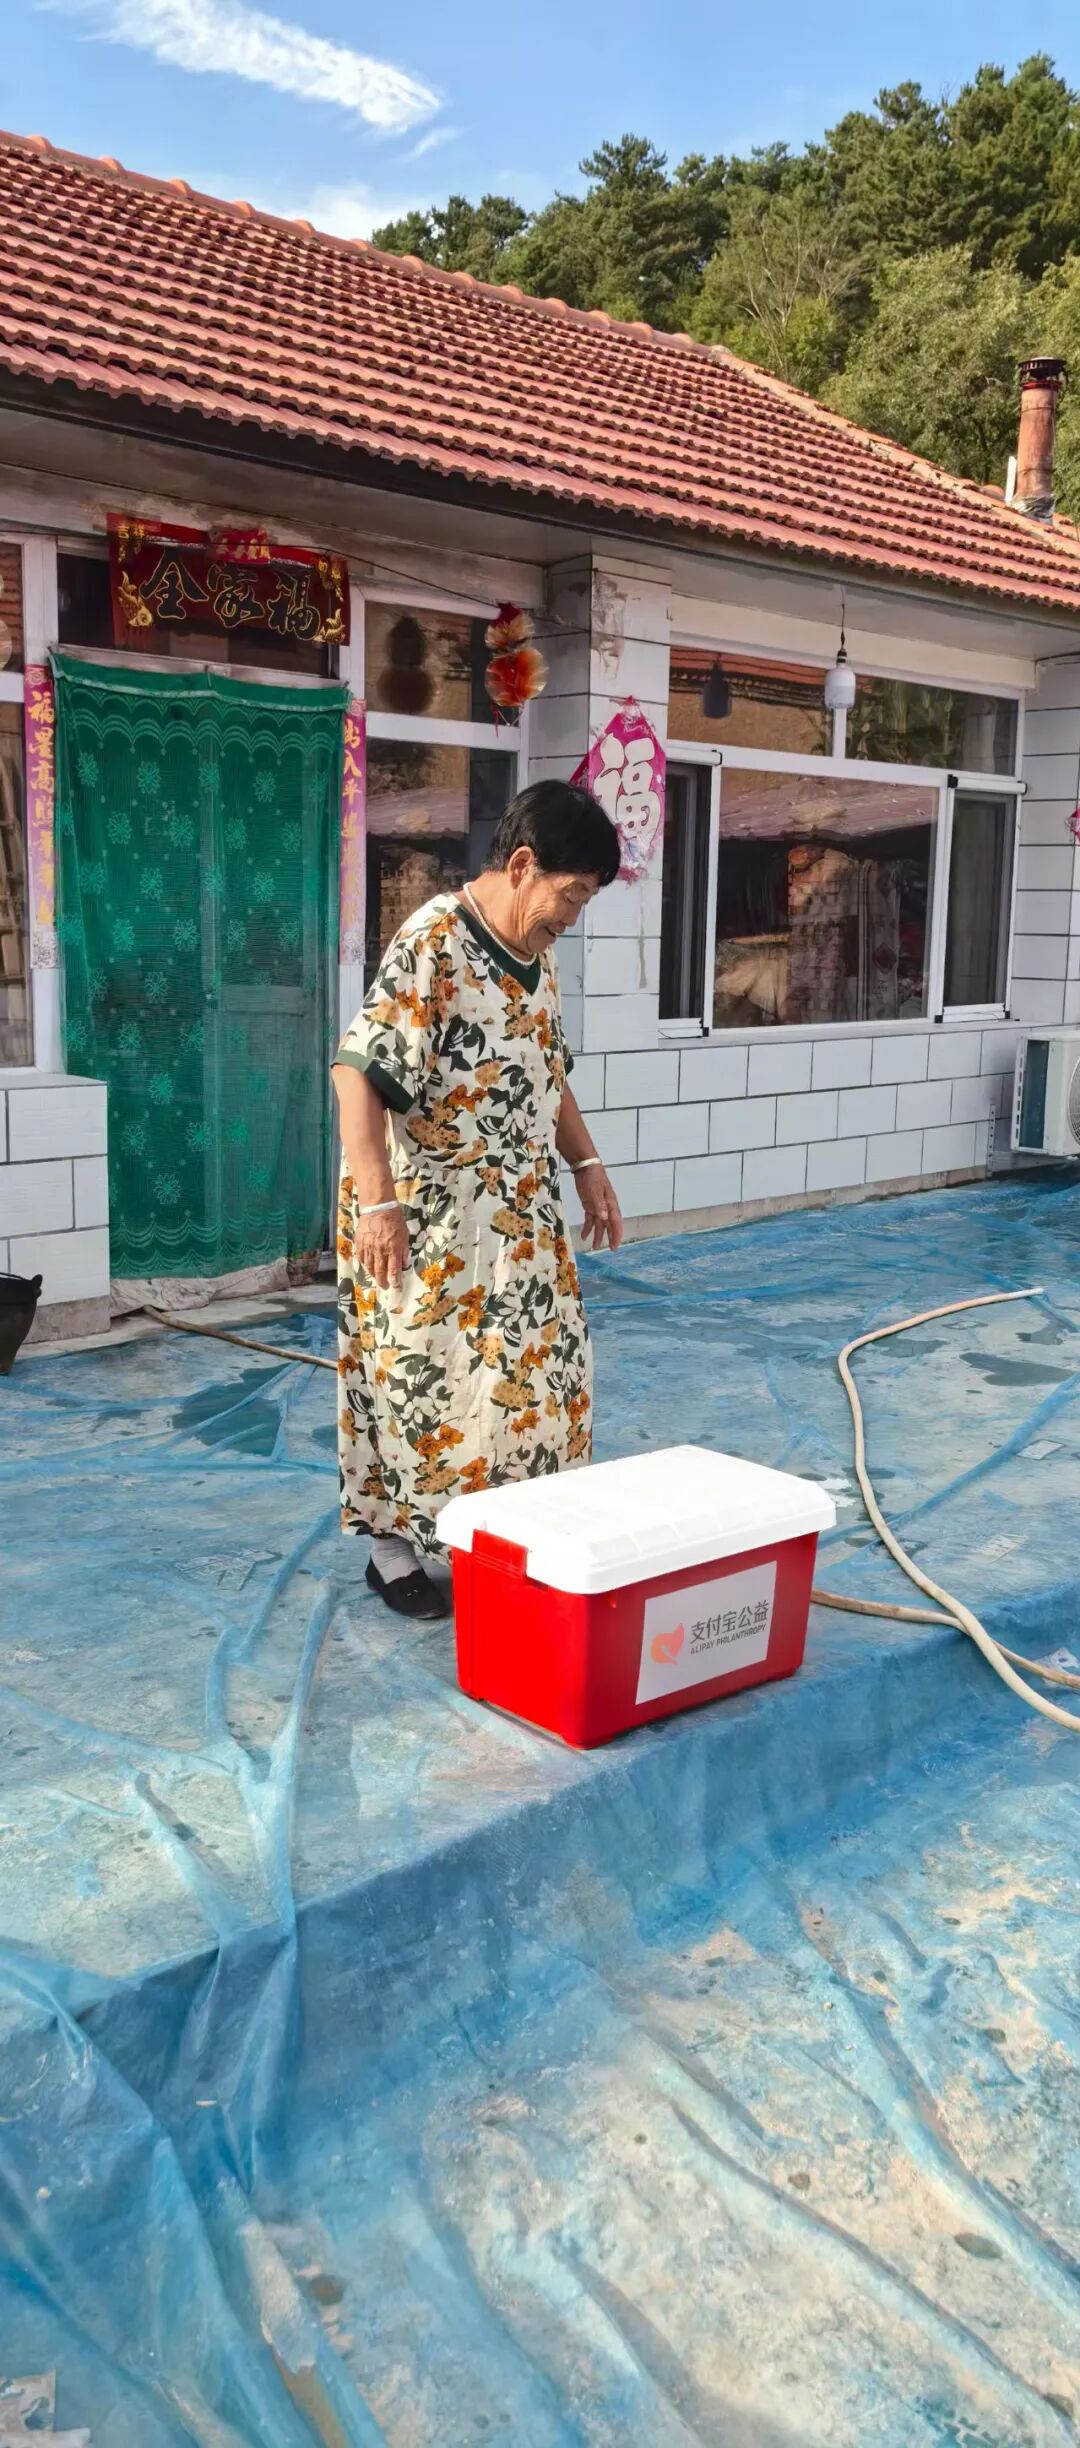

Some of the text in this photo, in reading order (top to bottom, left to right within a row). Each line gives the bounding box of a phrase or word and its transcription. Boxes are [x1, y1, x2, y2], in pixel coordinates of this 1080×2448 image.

[138, 547, 322, 641] 全家福
[28, 690, 55, 924] 福星高照
[342, 718, 363, 930] 出入平安
[593, 732, 661, 846] 福
[690, 1600, 768, 1644] 支付宝公益
[690, 1624, 766, 1655] ALIPAY PHILANTHROPY
